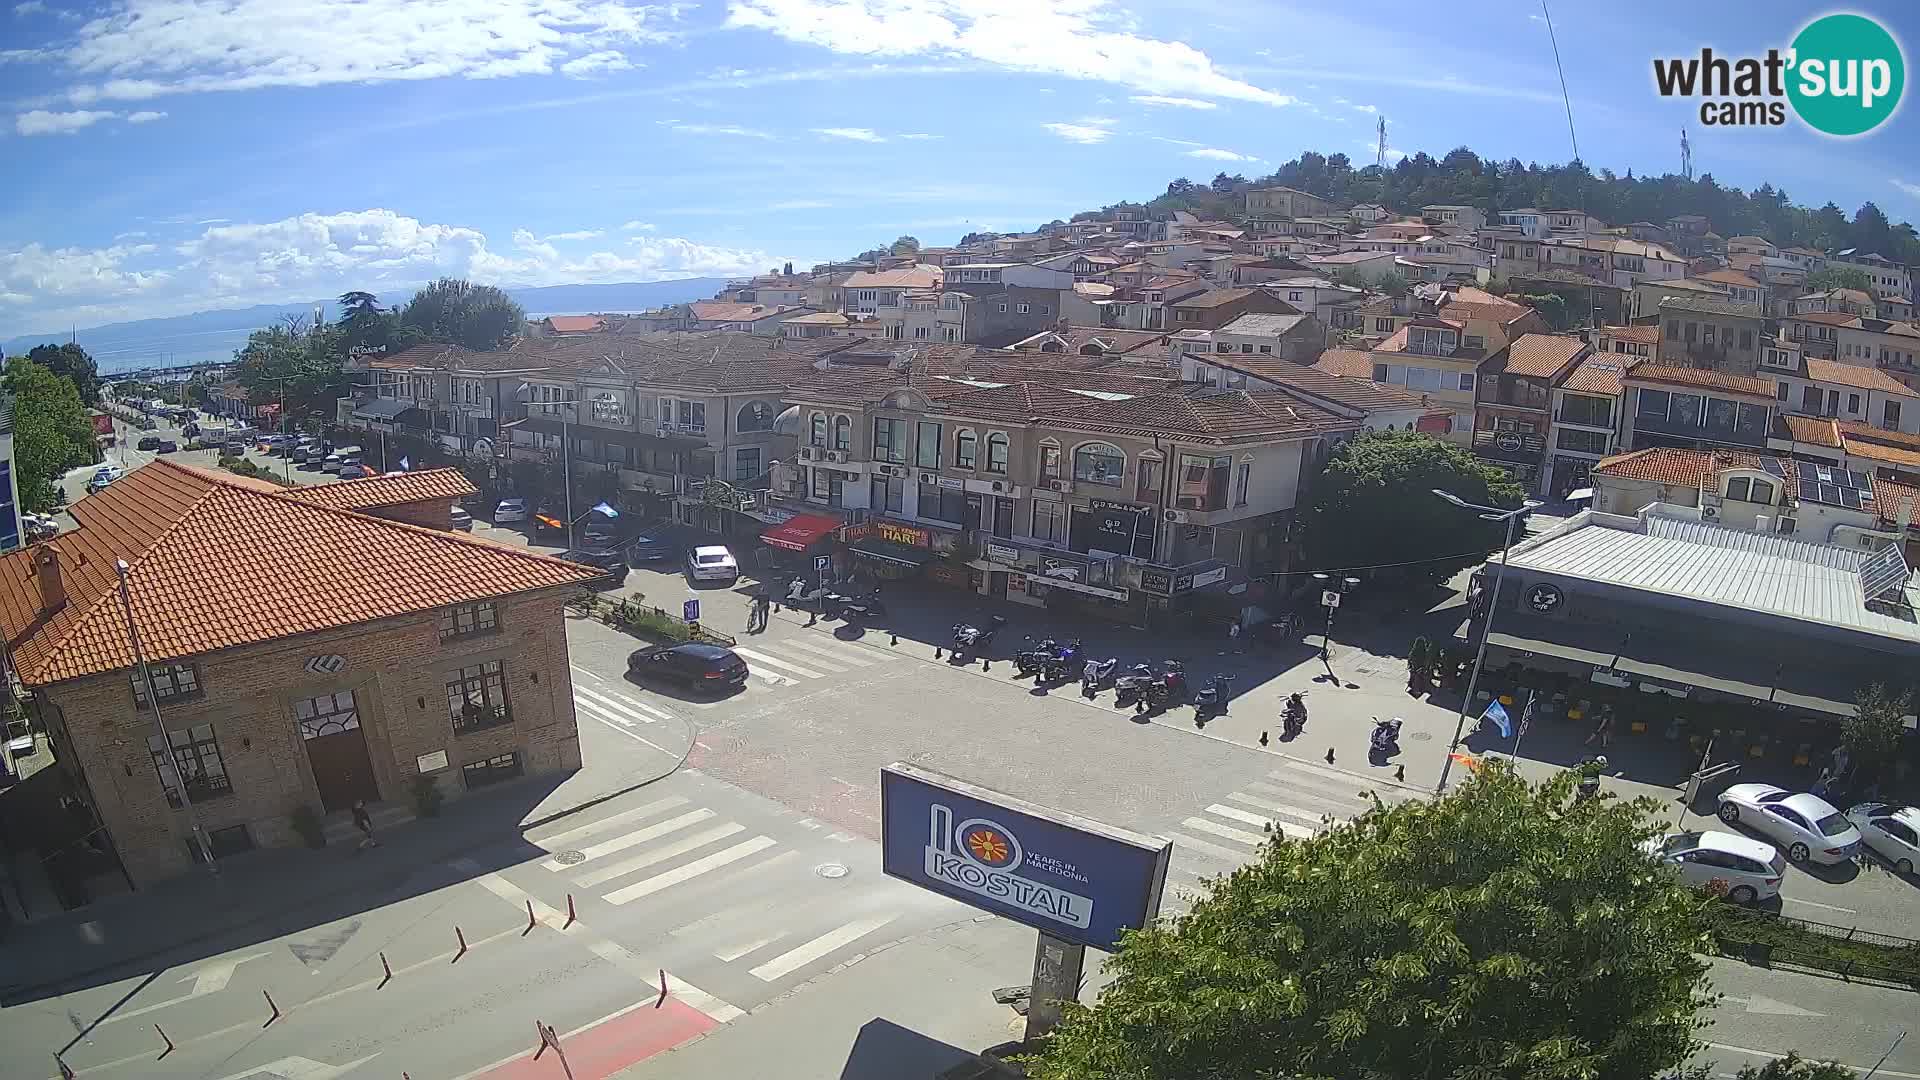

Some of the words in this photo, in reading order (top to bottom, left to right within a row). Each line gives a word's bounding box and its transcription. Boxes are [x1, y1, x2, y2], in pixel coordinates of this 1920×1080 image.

[817, 559, 826, 570] P
[1025, 858, 1090, 885] MACEDONIA
[1026, 851, 1063, 868] YEARS
[1063, 862, 1077, 873] IN
[932, 853, 1081, 924] KOSTAL
